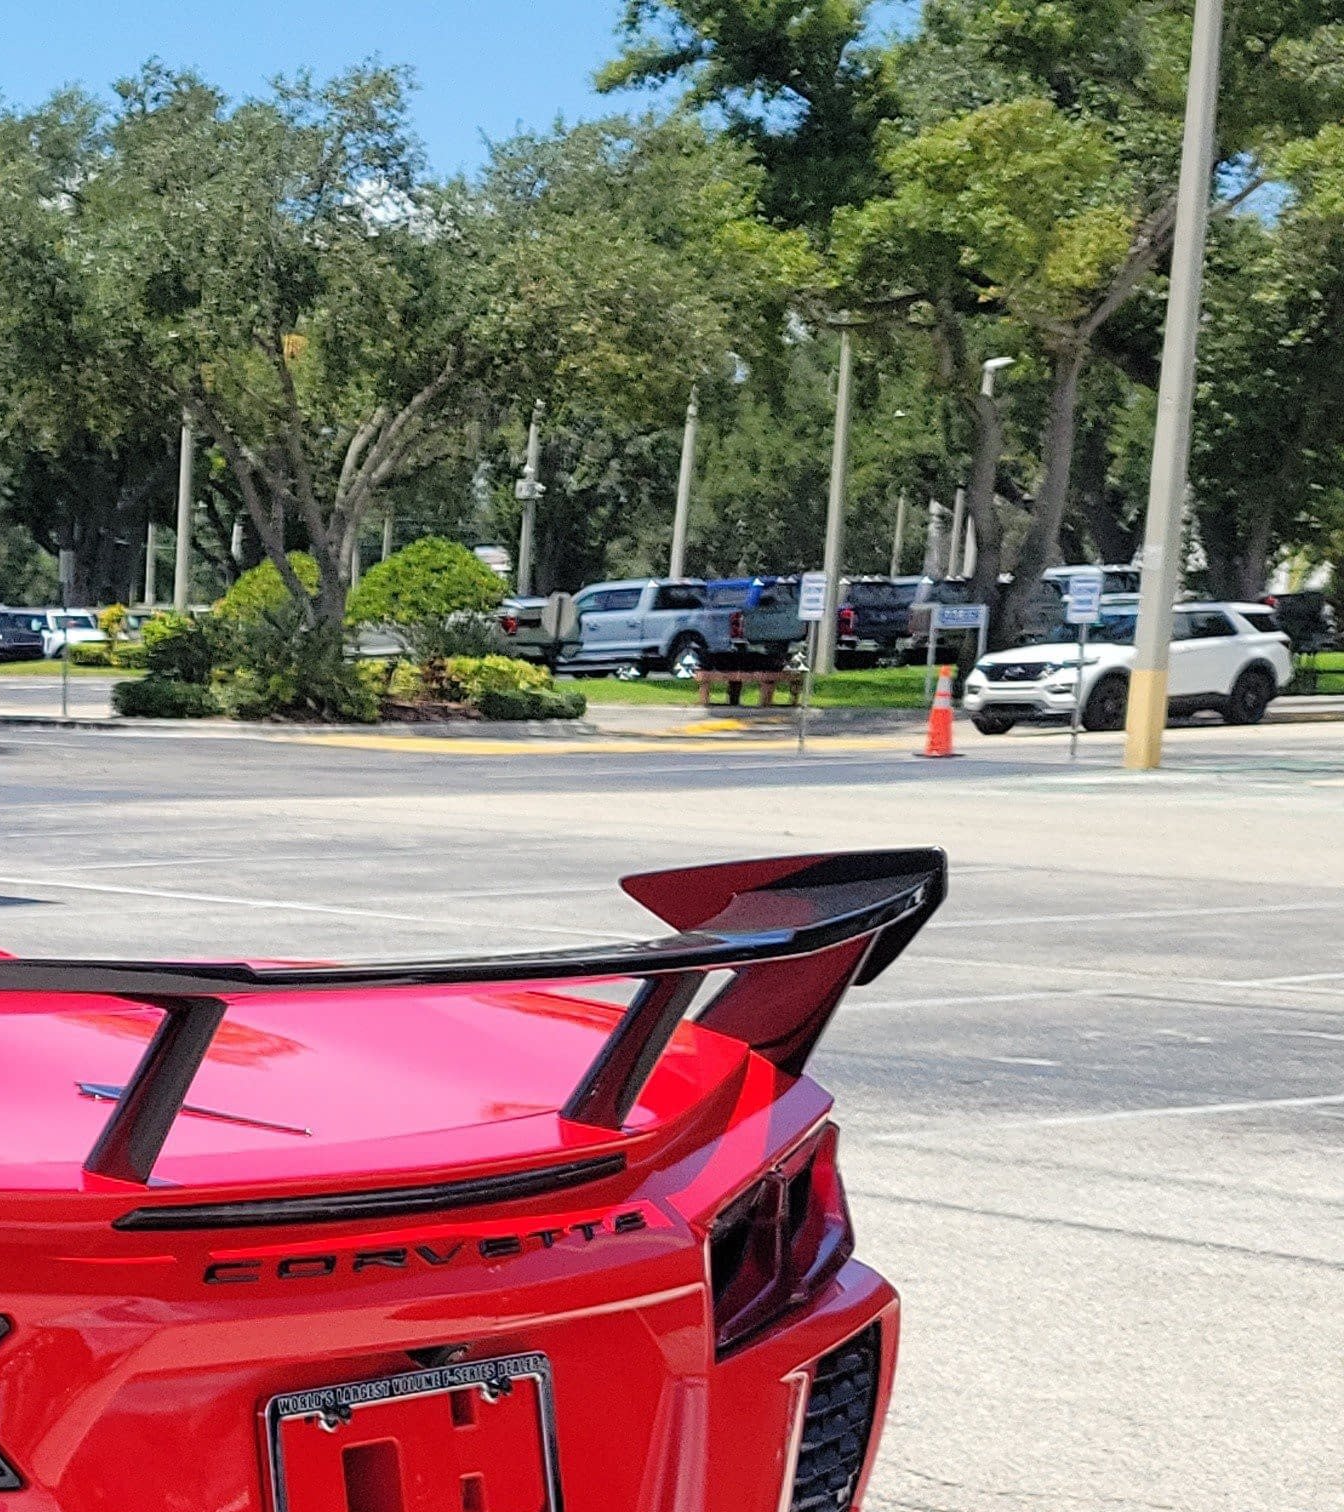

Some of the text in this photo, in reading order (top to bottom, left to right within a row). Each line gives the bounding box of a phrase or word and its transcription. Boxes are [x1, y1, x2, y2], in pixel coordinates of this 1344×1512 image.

[202, 1210, 648, 1284] CORVETTE
[278, 1390, 333, 1415] WORLD'S
[336, 1380, 391, 1404] LARGEST
[392, 1373, 441, 1395] VOLUME
[443, 1363, 496, 1388] F-SERIES
